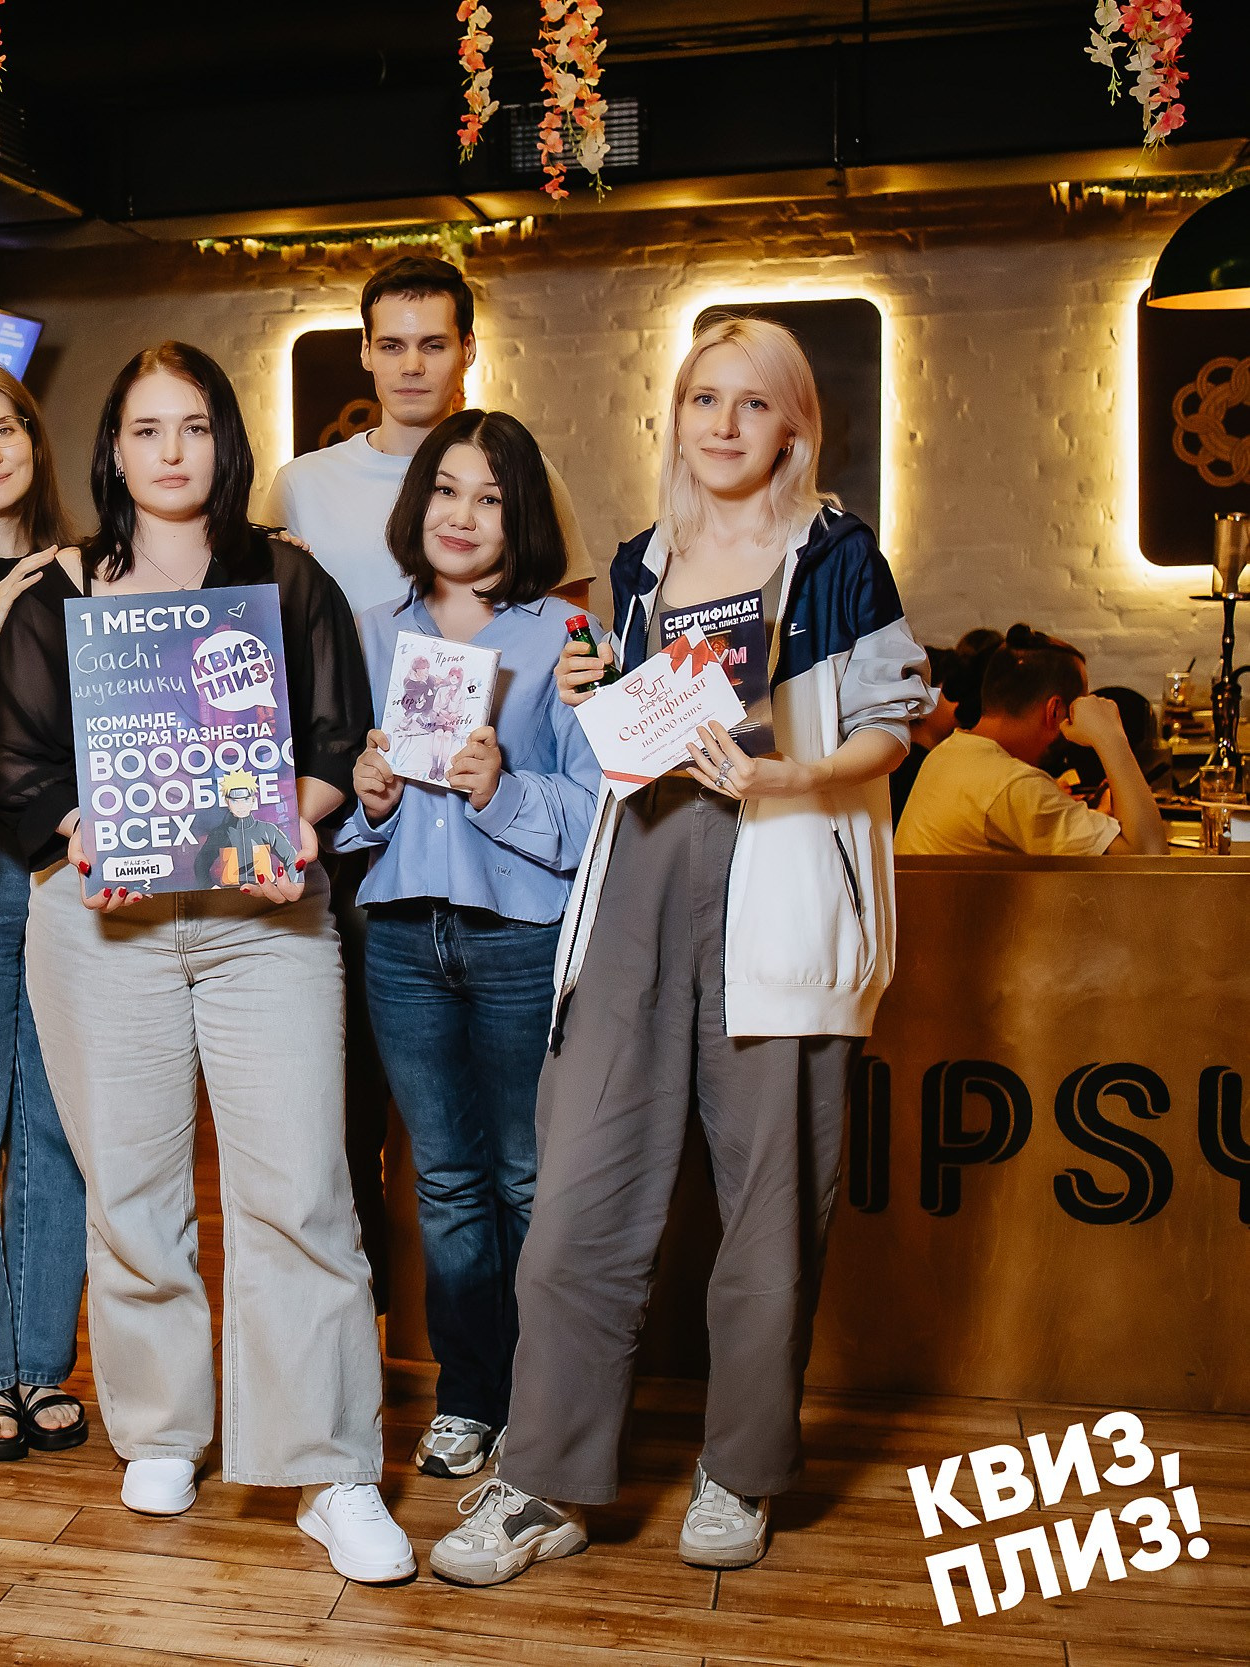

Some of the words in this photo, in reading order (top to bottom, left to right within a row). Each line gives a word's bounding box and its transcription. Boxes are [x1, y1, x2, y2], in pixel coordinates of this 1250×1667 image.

[80, 612, 93, 636] 1
[103, 604, 210, 635] МЕСТО
[664, 597, 759, 631] СЕРТИФИКАТ
[739, 612, 760, 624] ХОУМ
[75, 642, 162, 675] Gachi
[192, 638, 270, 680] КВИЗ,
[196, 658, 276, 702] ПЛИЗ!
[633, 674, 665, 704] ТУТ
[86, 712, 181, 732] КОМАНДЕ,
[618, 677, 706, 741] Сертификат
[87, 729, 172, 750] КОТОРАЯ
[177, 721, 273, 744] РАЗНЕСЛА
[641, 737, 655, 748] на
[654, 719, 677, 740] 1000
[94, 814, 199, 852] ВСЕХ
[115, 864, 160, 878] [АНИМЕ]
